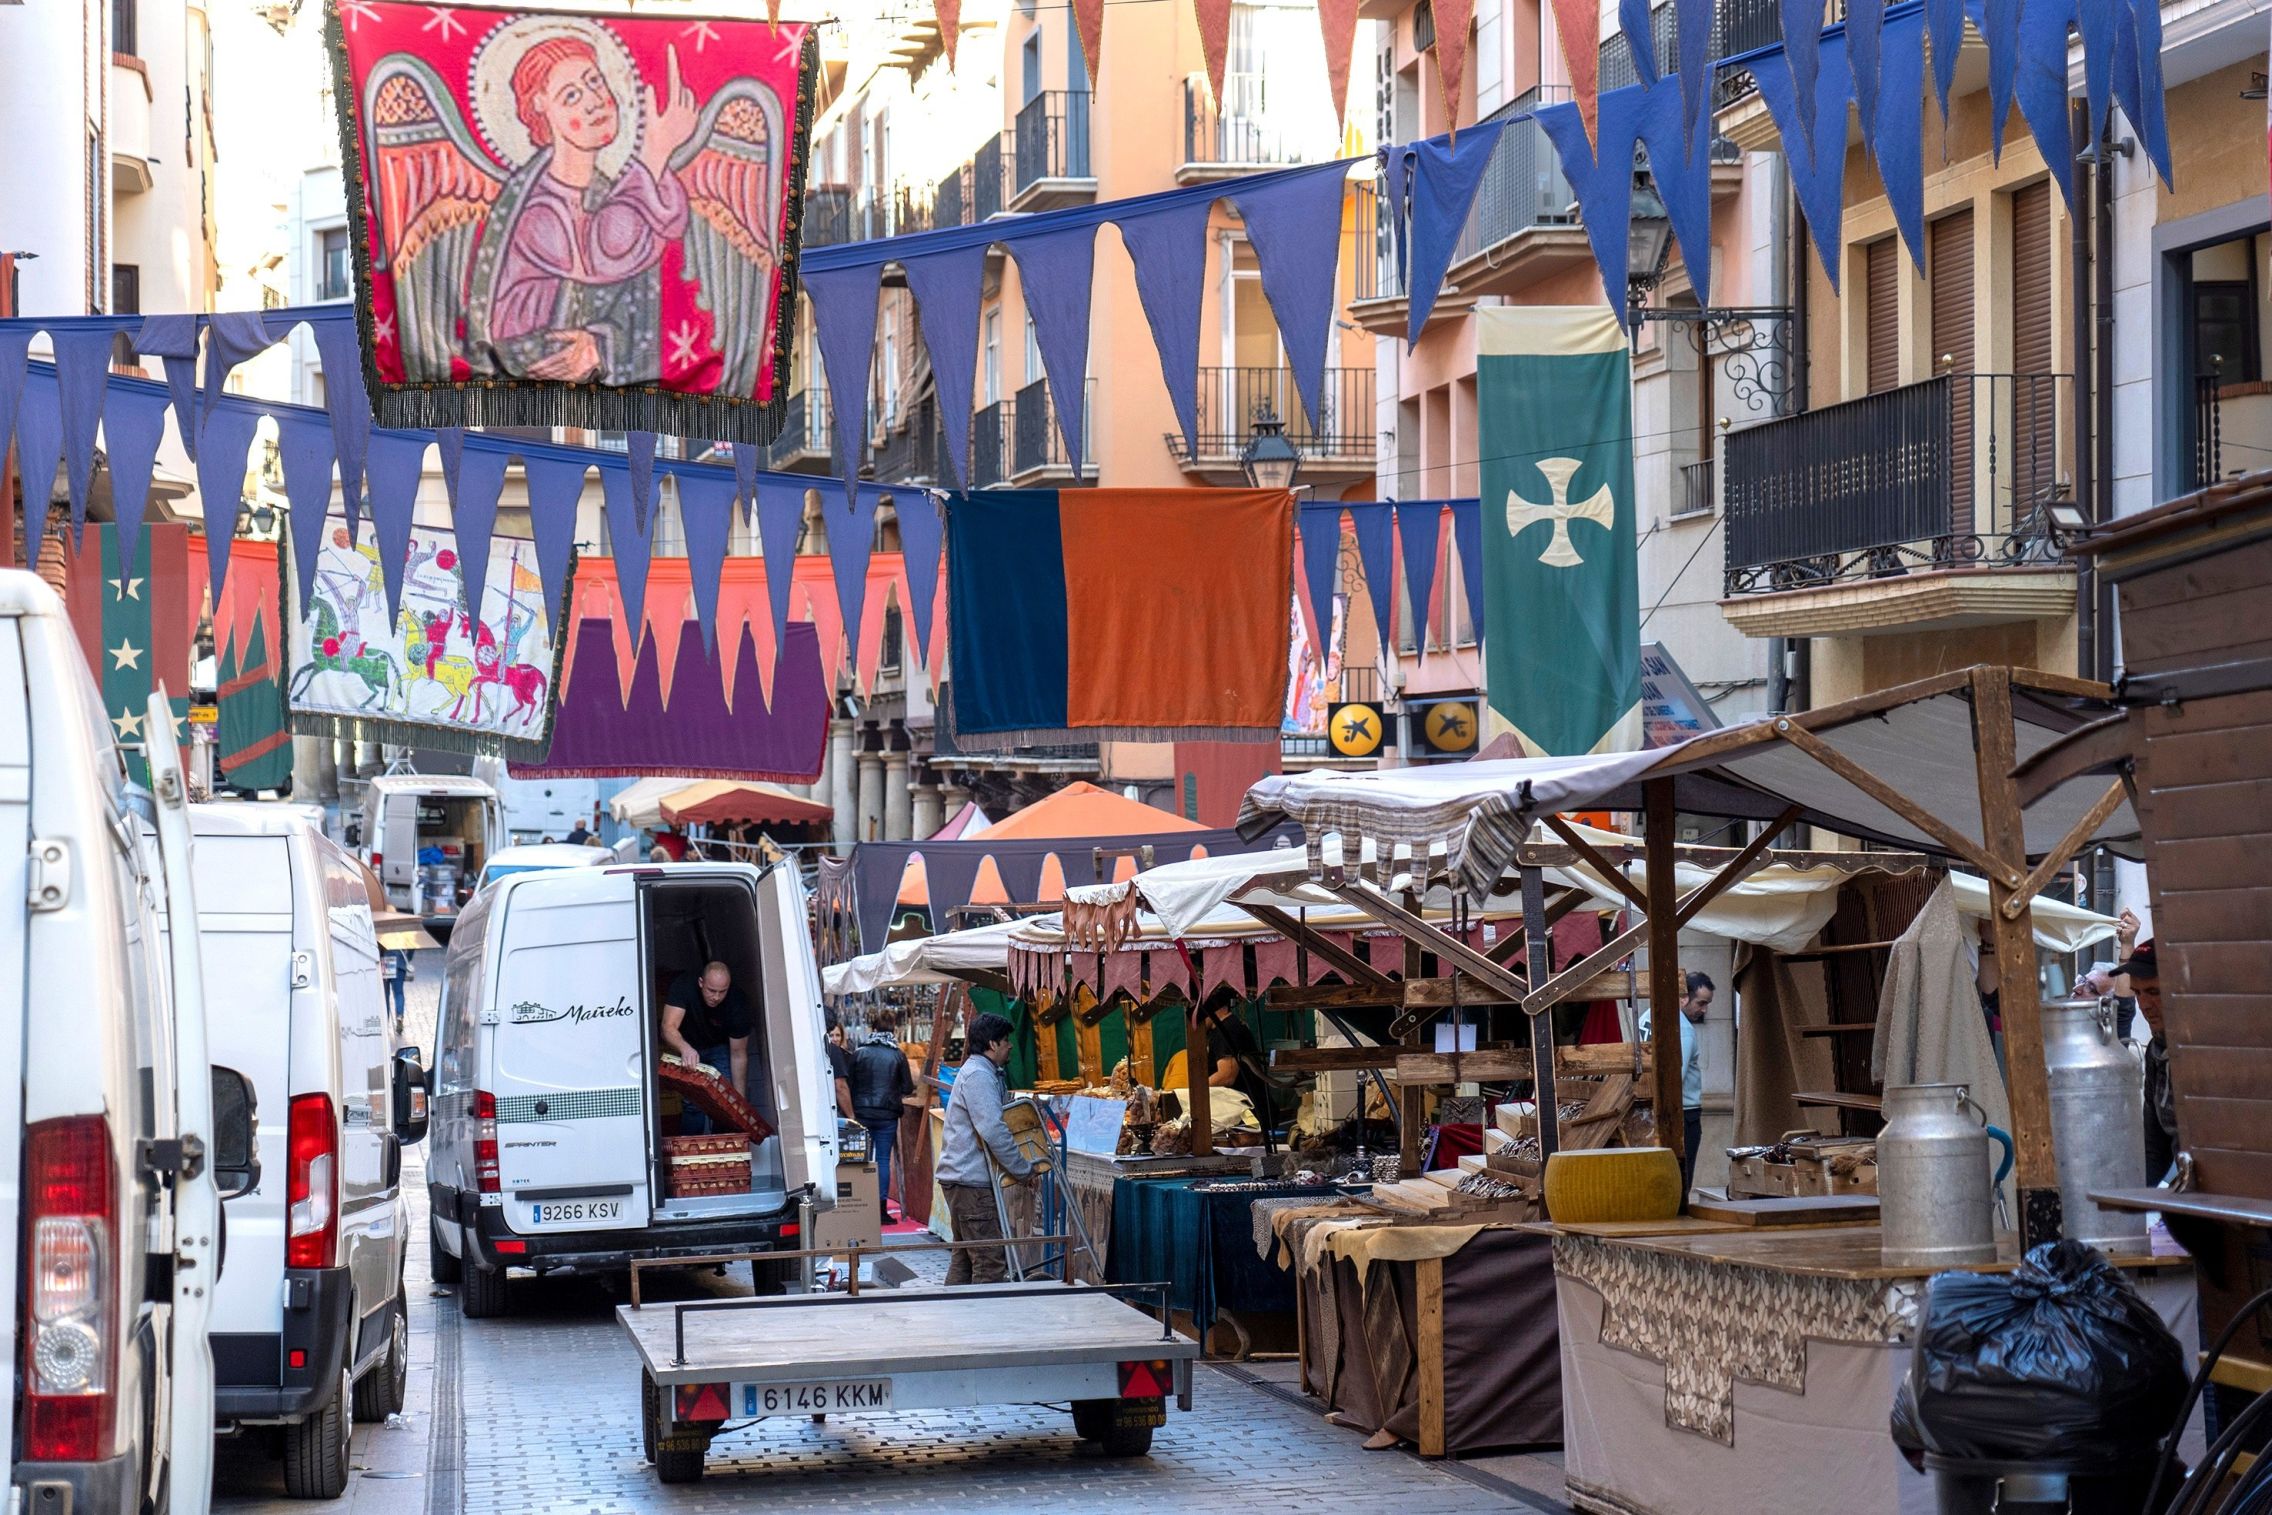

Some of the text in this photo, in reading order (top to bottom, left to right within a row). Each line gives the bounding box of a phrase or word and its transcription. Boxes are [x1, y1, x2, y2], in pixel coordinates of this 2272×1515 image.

[1644, 656, 1671, 675] SAN
[543, 1202, 619, 1221] 9266 KSV
[764, 1386, 827, 1411] 6146
[836, 1384, 883, 1408] KKM
